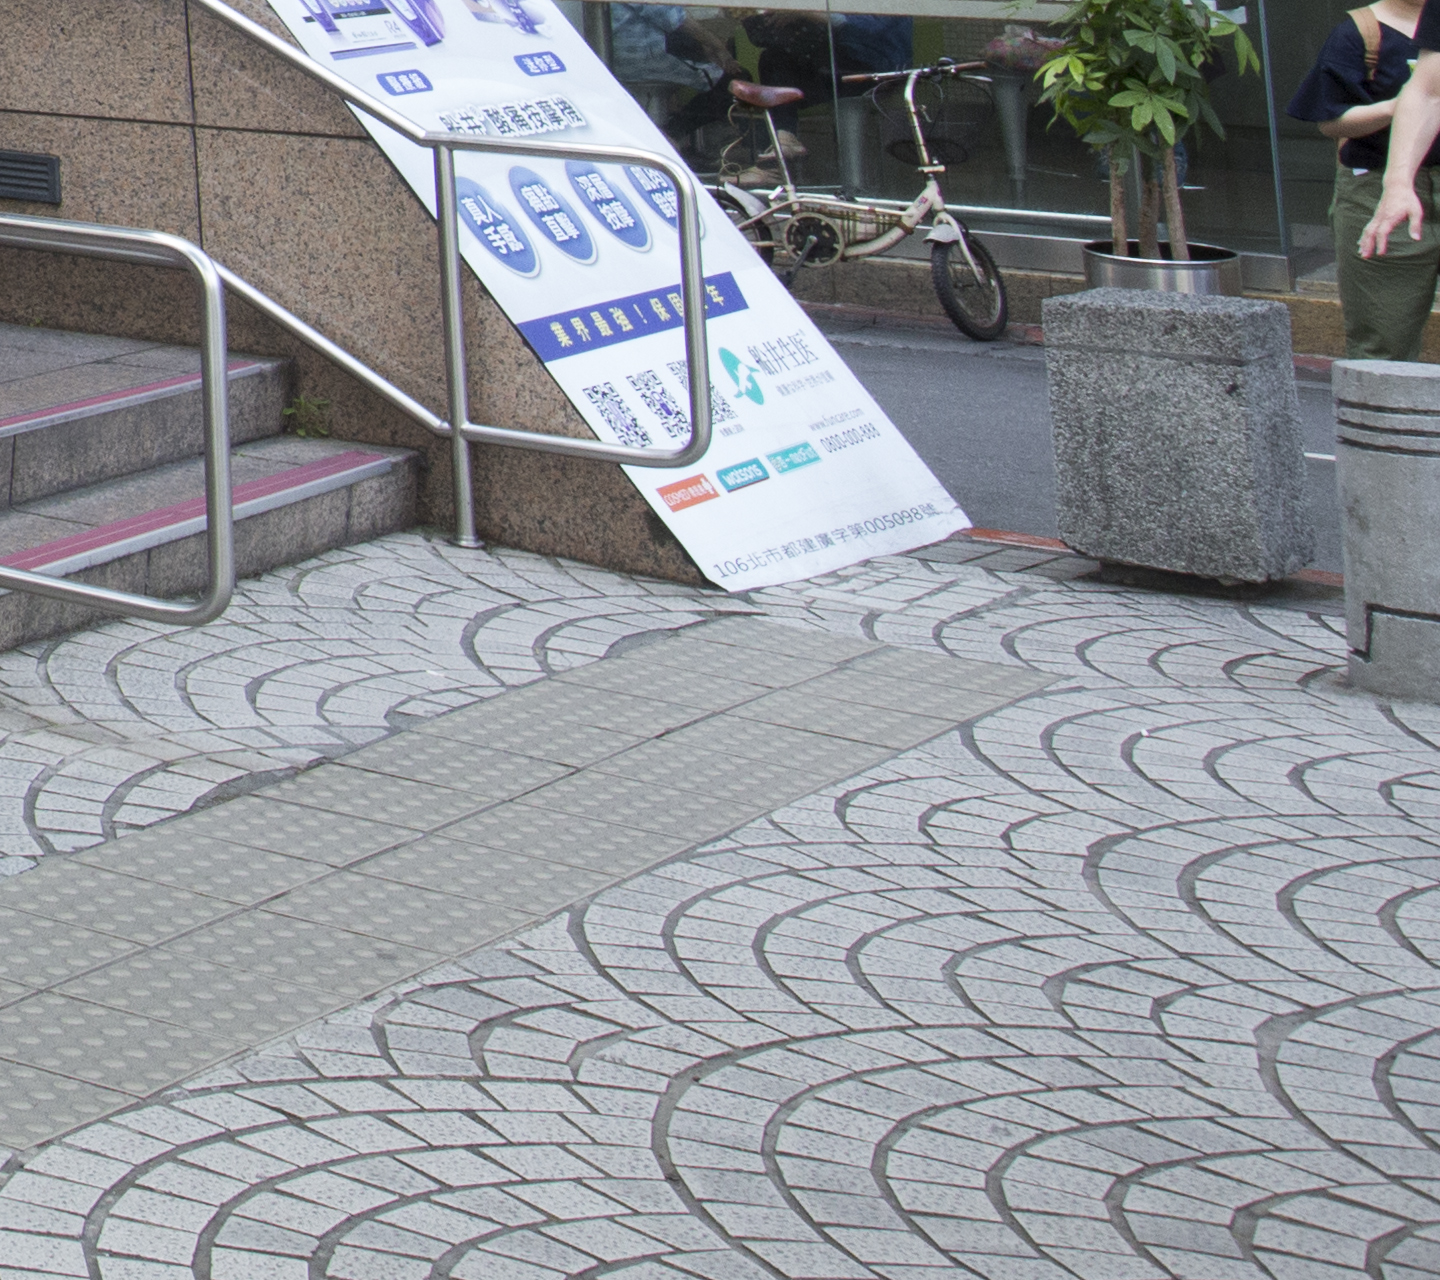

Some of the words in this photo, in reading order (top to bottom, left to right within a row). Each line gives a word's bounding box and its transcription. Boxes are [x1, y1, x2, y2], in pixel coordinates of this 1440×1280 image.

[520, 183, 559, 212] 痛點
[575, 173, 614, 202] 深層
[461, 195, 502, 224] 真人
[597, 201, 634, 230] 按摩
[484, 223, 525, 254] 手感
[542, 212, 579, 241] 直擊
[809, 408, 864, 433] www.funcare.com
[820, 422, 881, 453] 0800-000-888
[722, 462, 764, 486] watsons
[664, 485, 690, 507] COSMED
